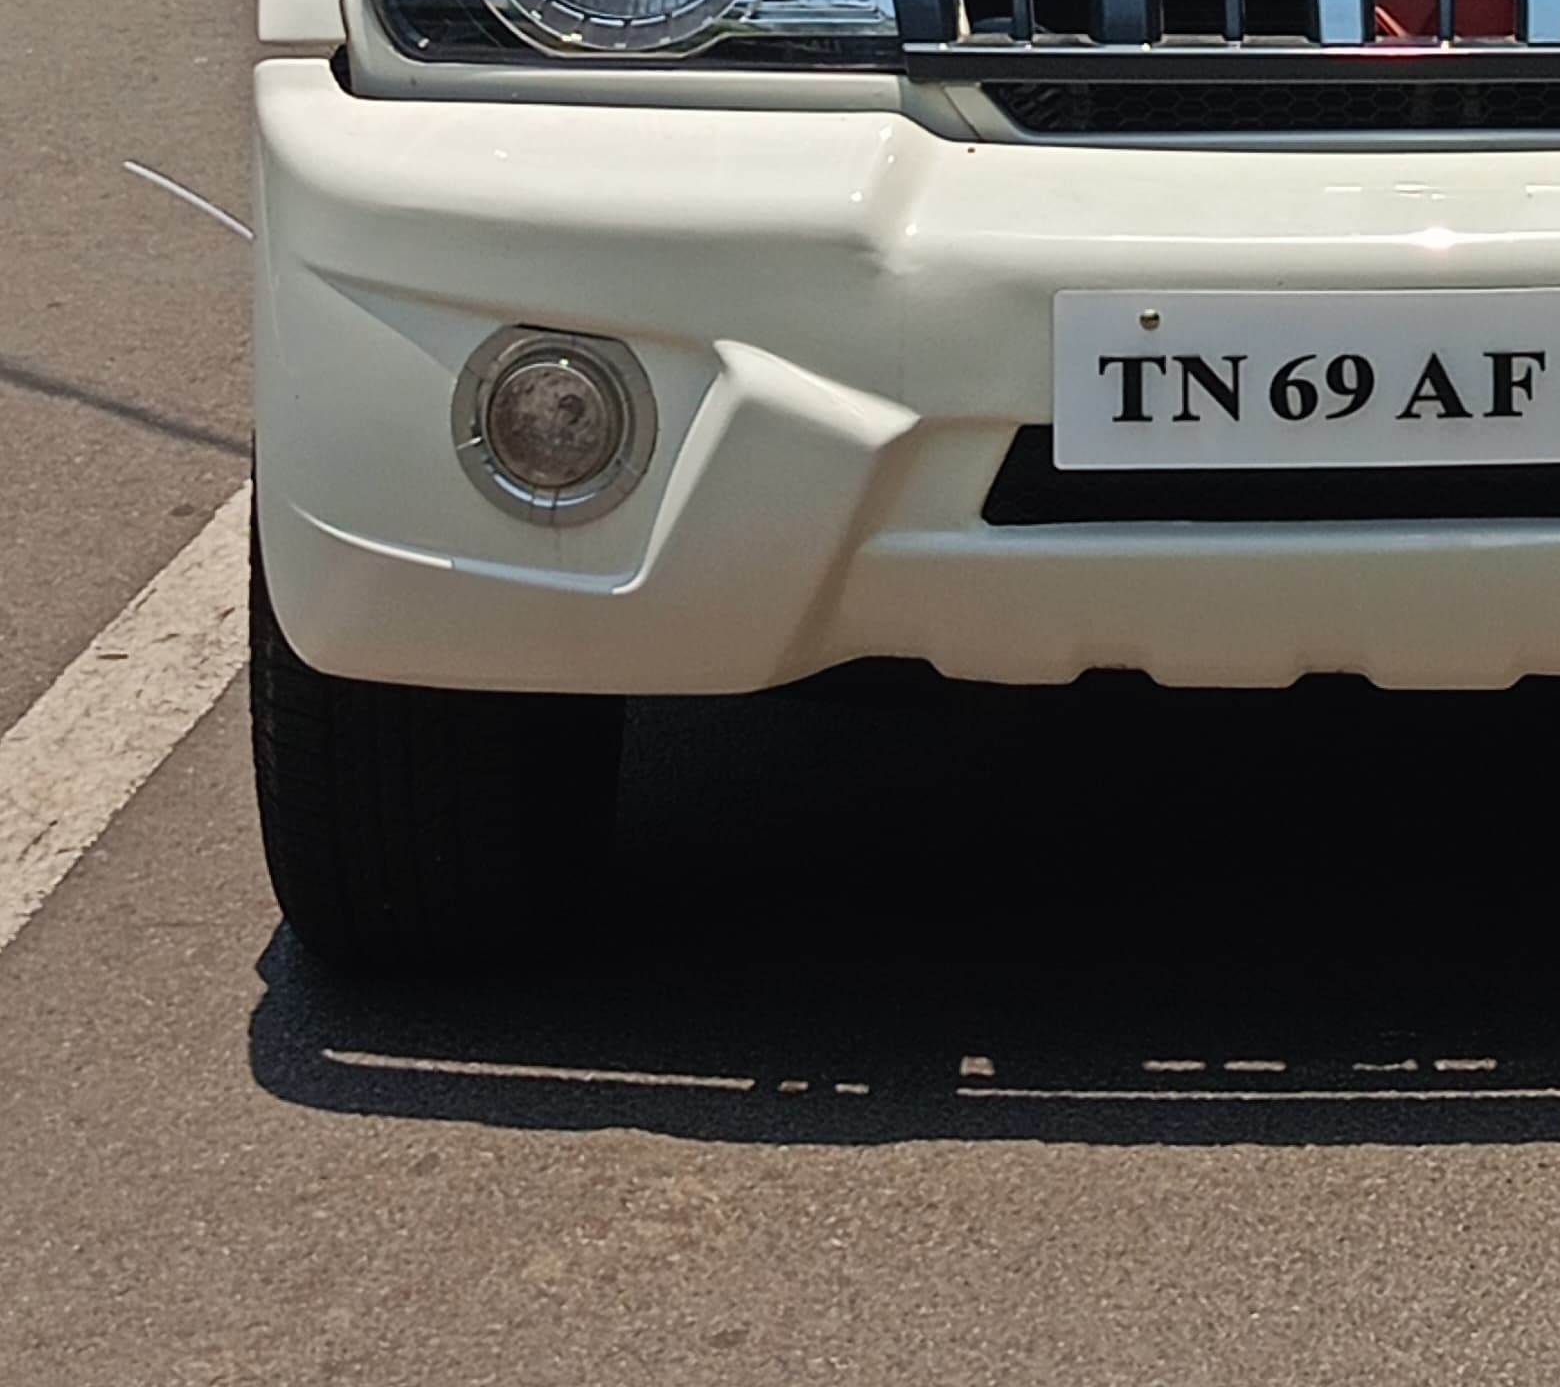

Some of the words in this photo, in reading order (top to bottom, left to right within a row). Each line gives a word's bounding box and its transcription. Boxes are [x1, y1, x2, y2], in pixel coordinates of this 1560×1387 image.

[1098, 354, 1249, 423] TN
[1268, 354, 1376, 422] 69
[1395, 350, 1547, 421] AF
